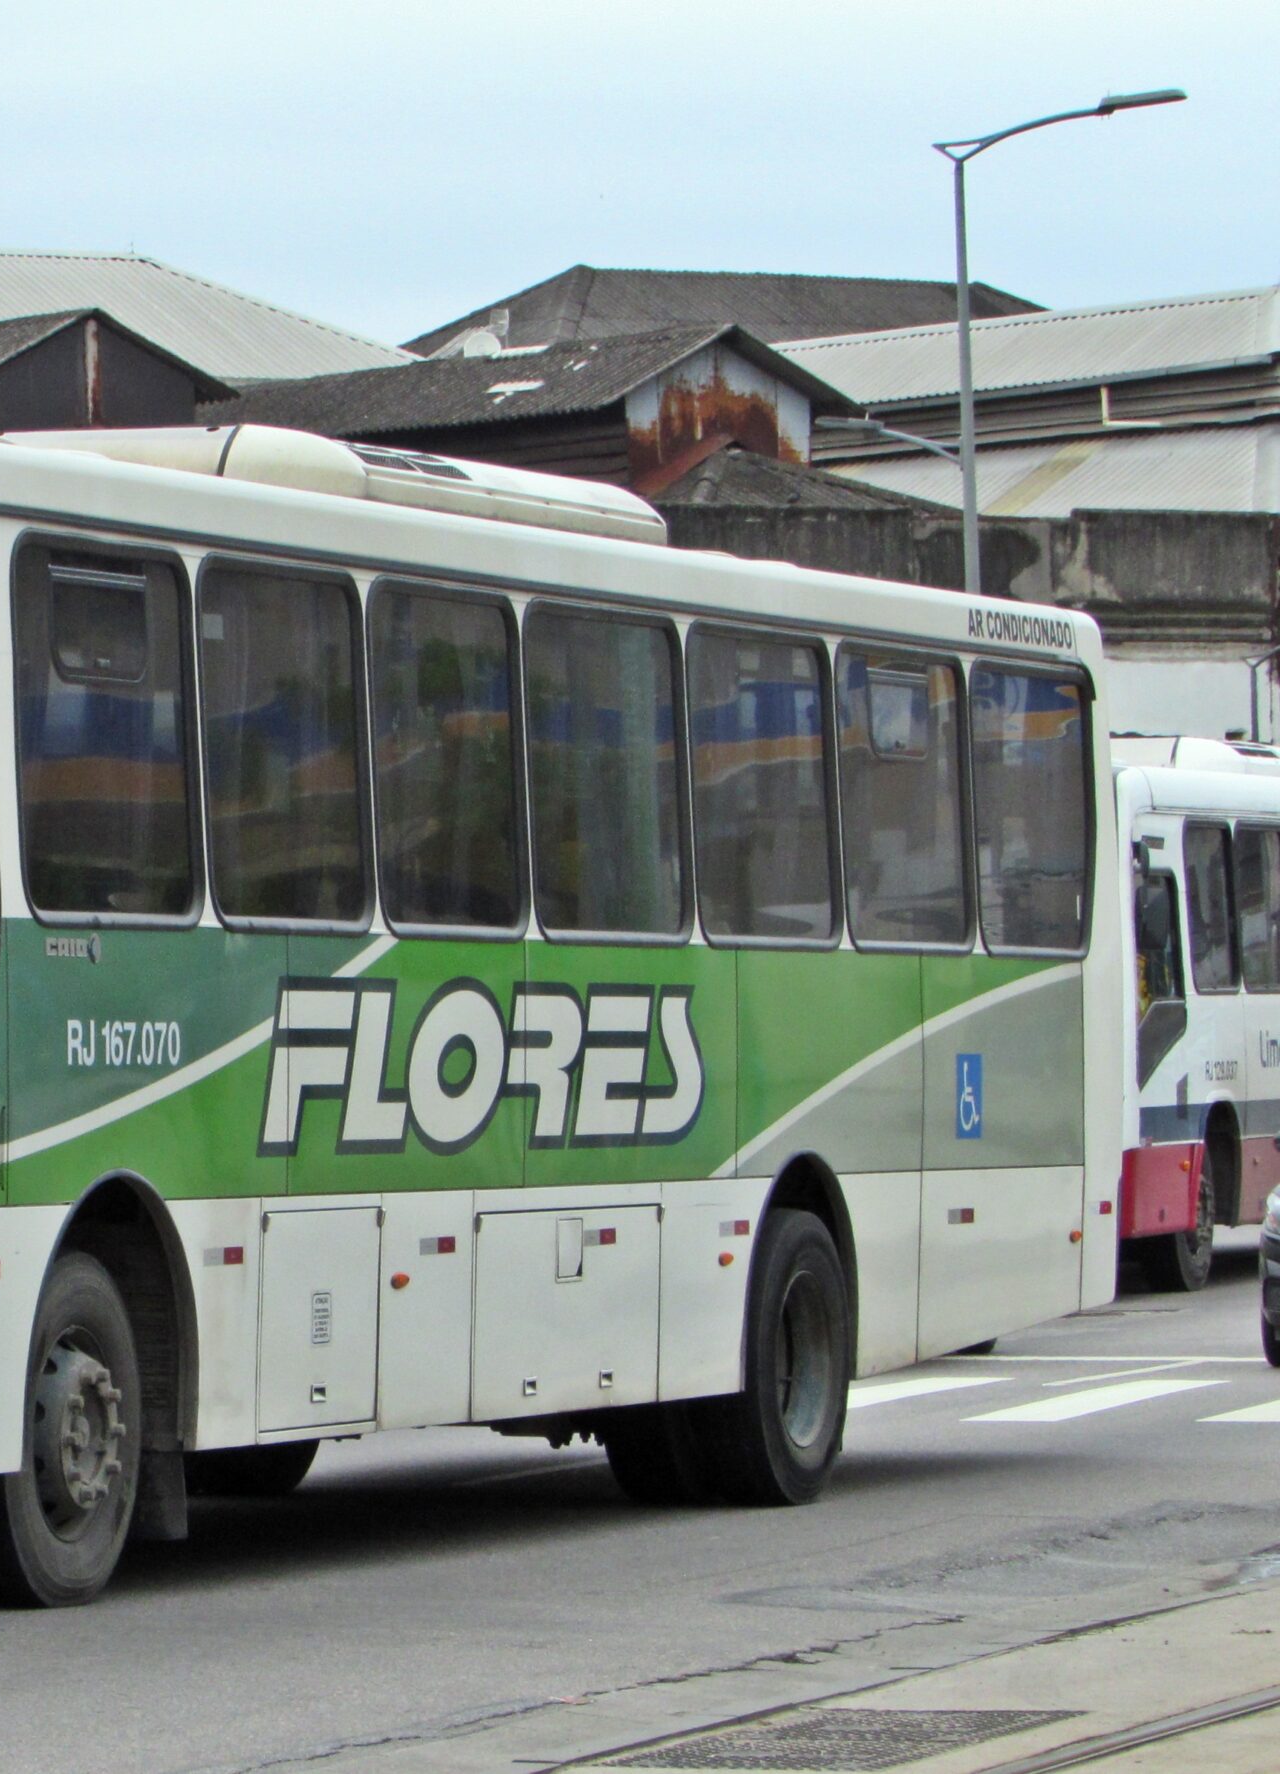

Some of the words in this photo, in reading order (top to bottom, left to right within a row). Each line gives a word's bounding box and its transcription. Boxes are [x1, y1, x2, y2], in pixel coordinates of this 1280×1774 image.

[969, 608, 984, 638] AR
[986, 611, 1072, 649] CONDICIONADO
[46, 937, 89, 957] CAIO
[67, 1019, 95, 1066] RJ
[102, 1021, 180, 1066] 167.070
[257, 976, 706, 1157] FLORES
